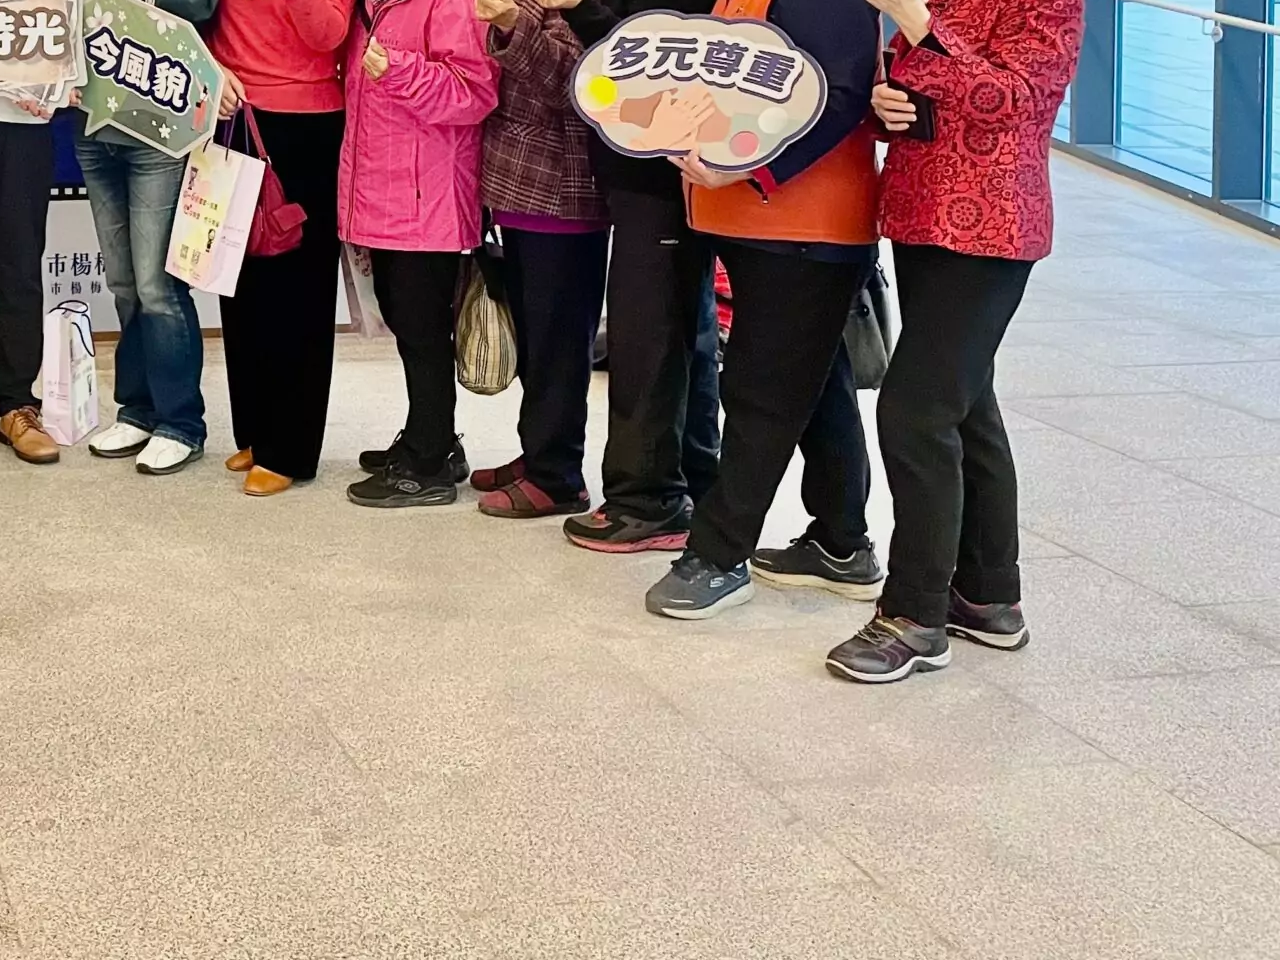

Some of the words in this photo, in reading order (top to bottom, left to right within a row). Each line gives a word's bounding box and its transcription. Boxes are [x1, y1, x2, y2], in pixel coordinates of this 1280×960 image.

[88, 31, 190, 108] 今風貌
[609, 36, 796, 93] 多元尊重
